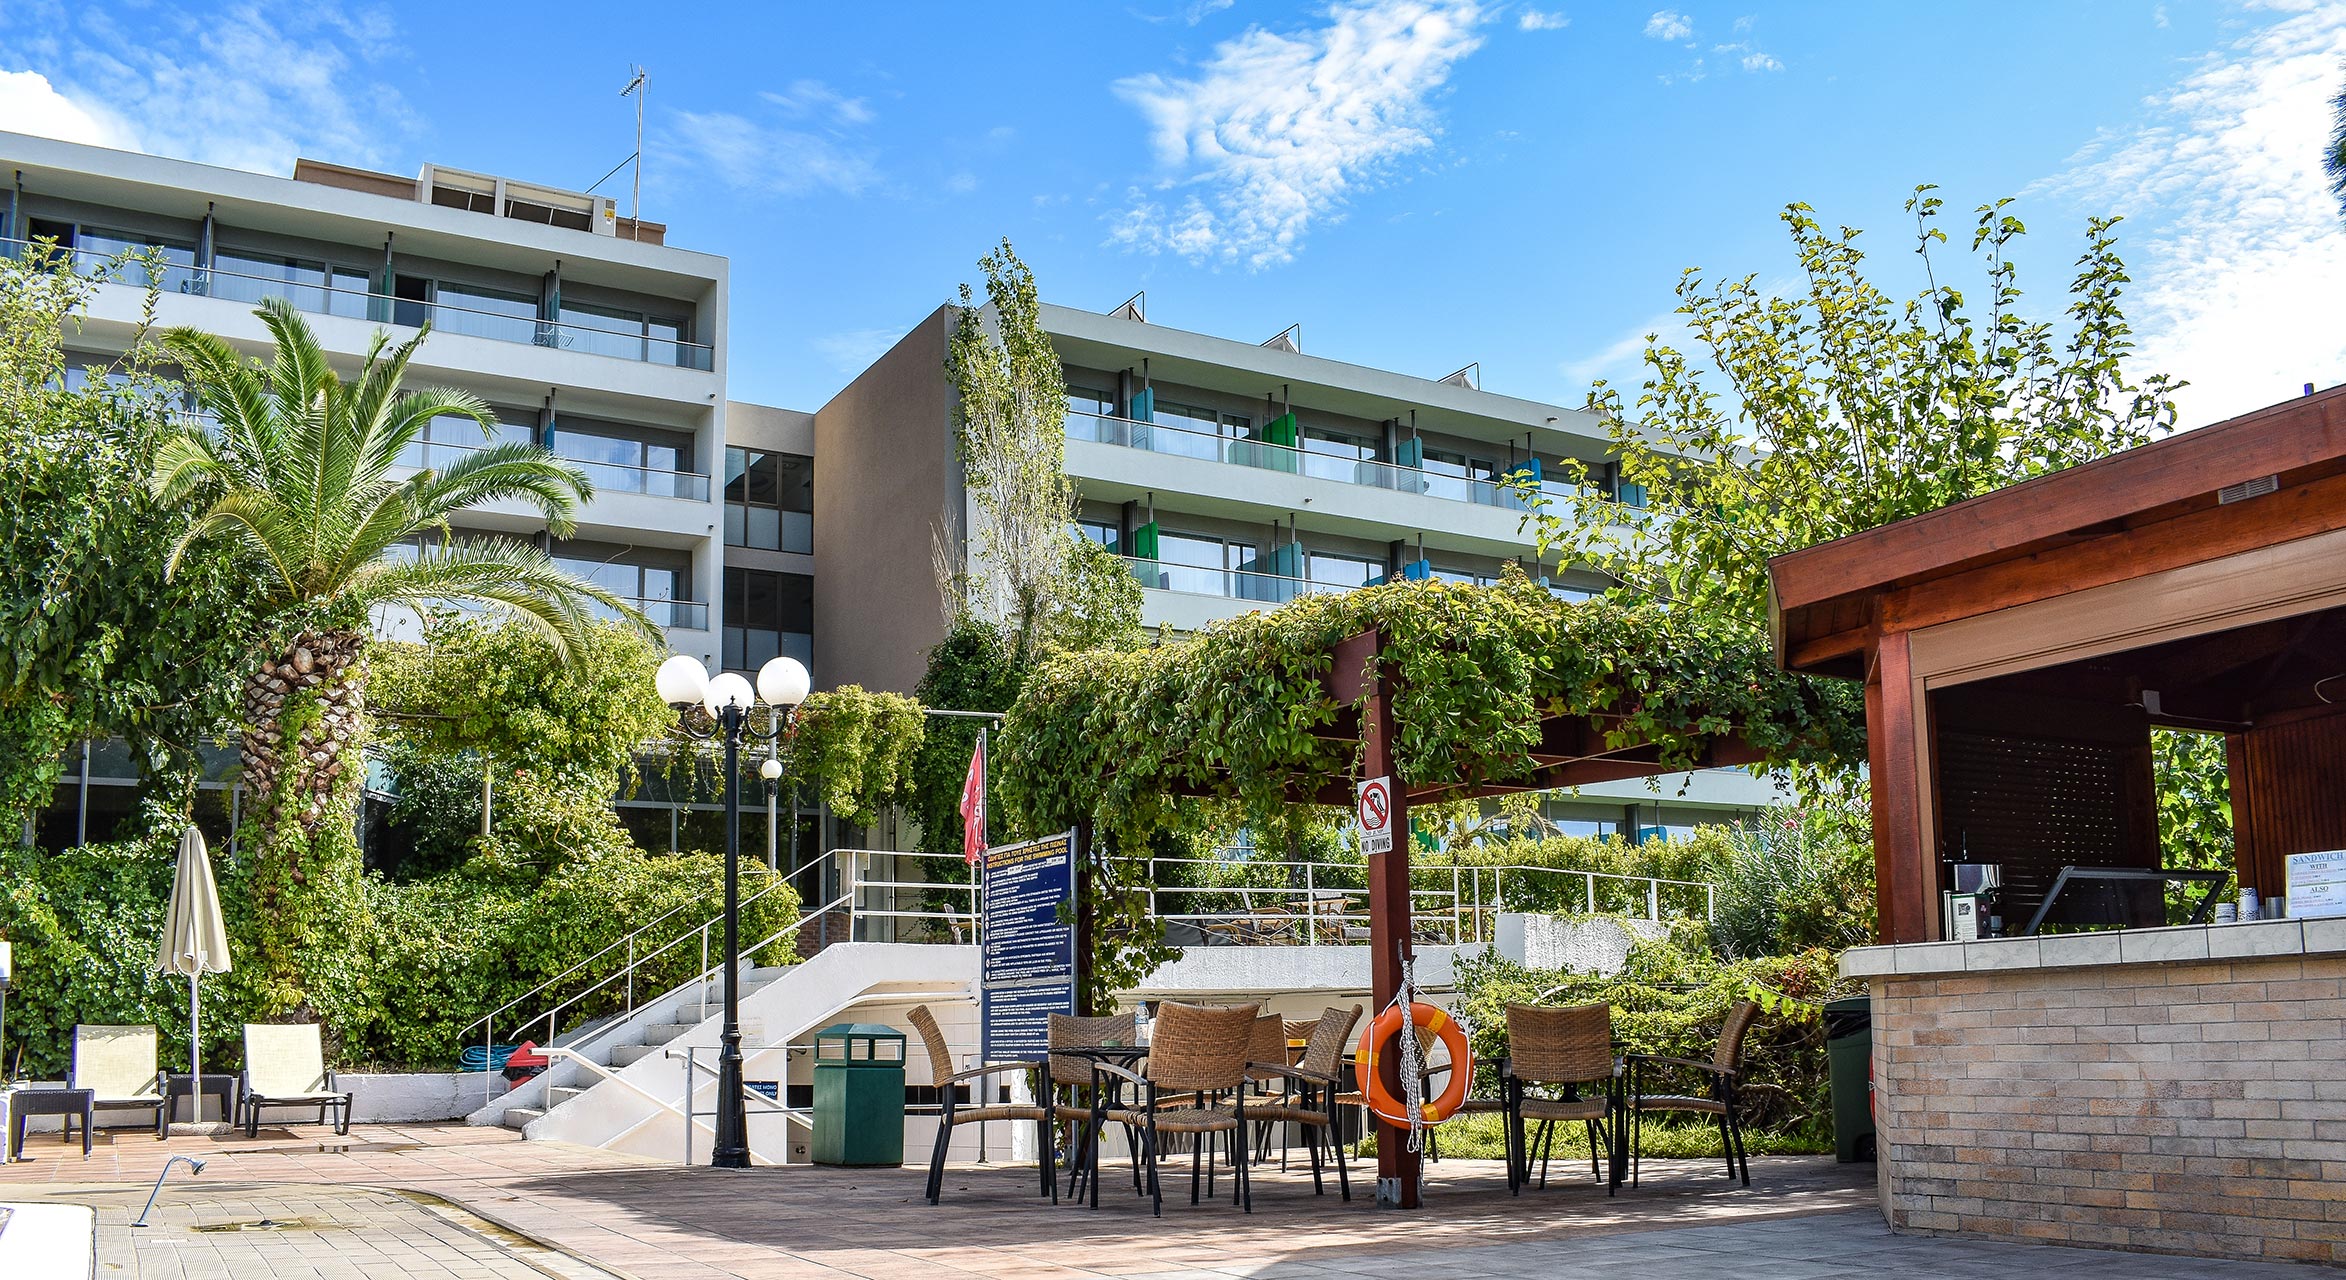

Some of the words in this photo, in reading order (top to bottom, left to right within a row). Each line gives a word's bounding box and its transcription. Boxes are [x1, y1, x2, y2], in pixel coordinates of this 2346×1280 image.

[1361, 841, 1369, 852] NO
[1372, 837, 1390, 851] DIVING
[2292, 852, 2343, 864] SANDWICH
